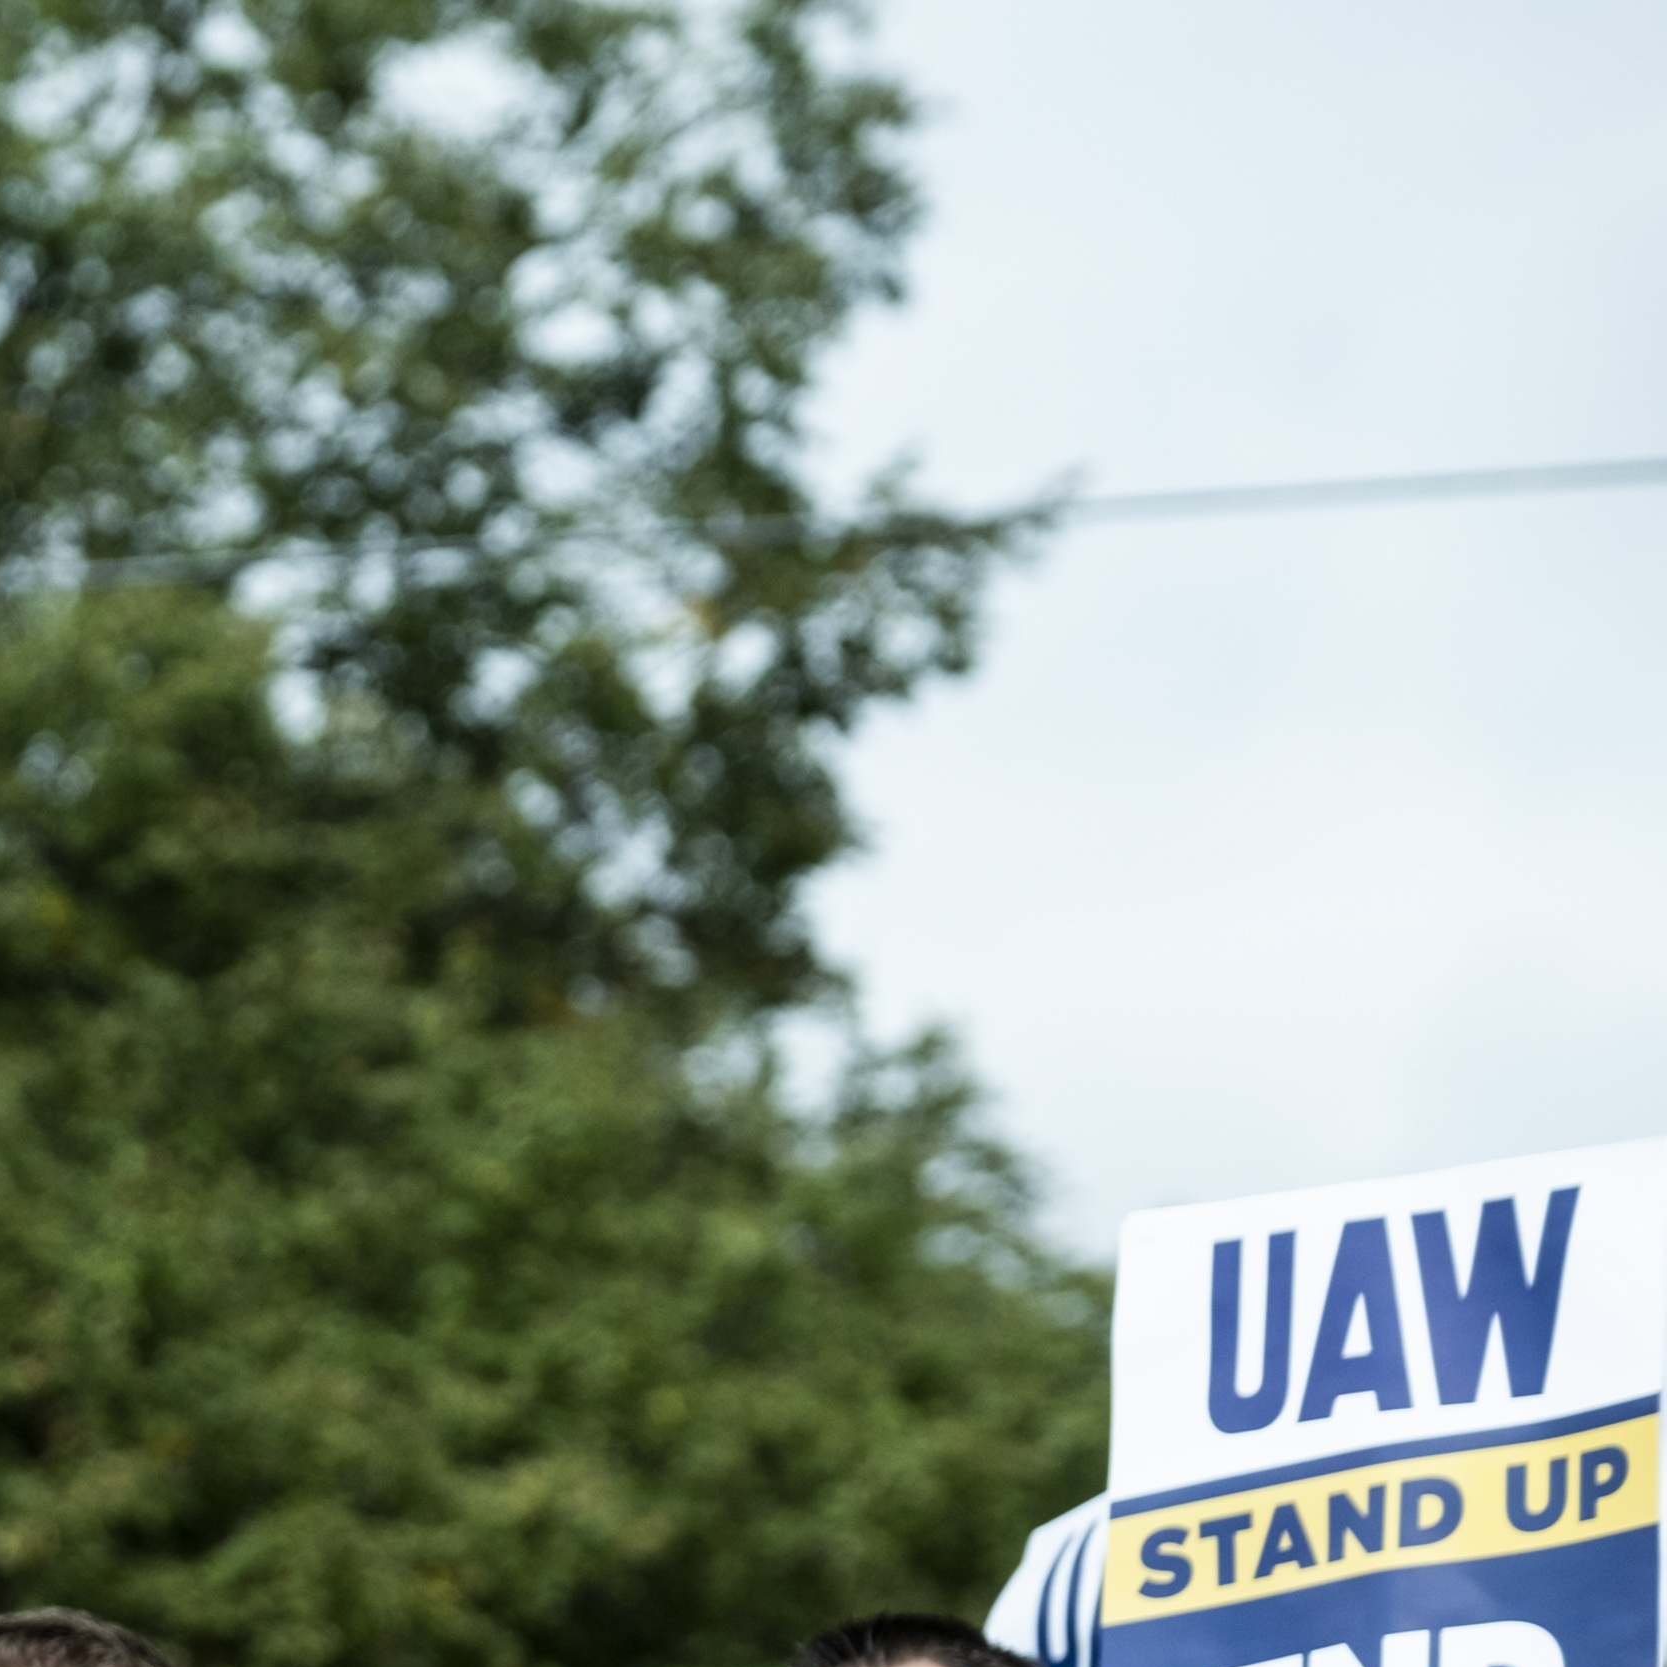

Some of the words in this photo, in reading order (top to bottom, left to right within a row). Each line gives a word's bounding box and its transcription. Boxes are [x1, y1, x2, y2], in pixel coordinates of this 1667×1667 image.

[1208, 1184, 1583, 1434] UAW
[1137, 1475, 1464, 1600] STAND
[1505, 1444, 1629, 1533] UP
